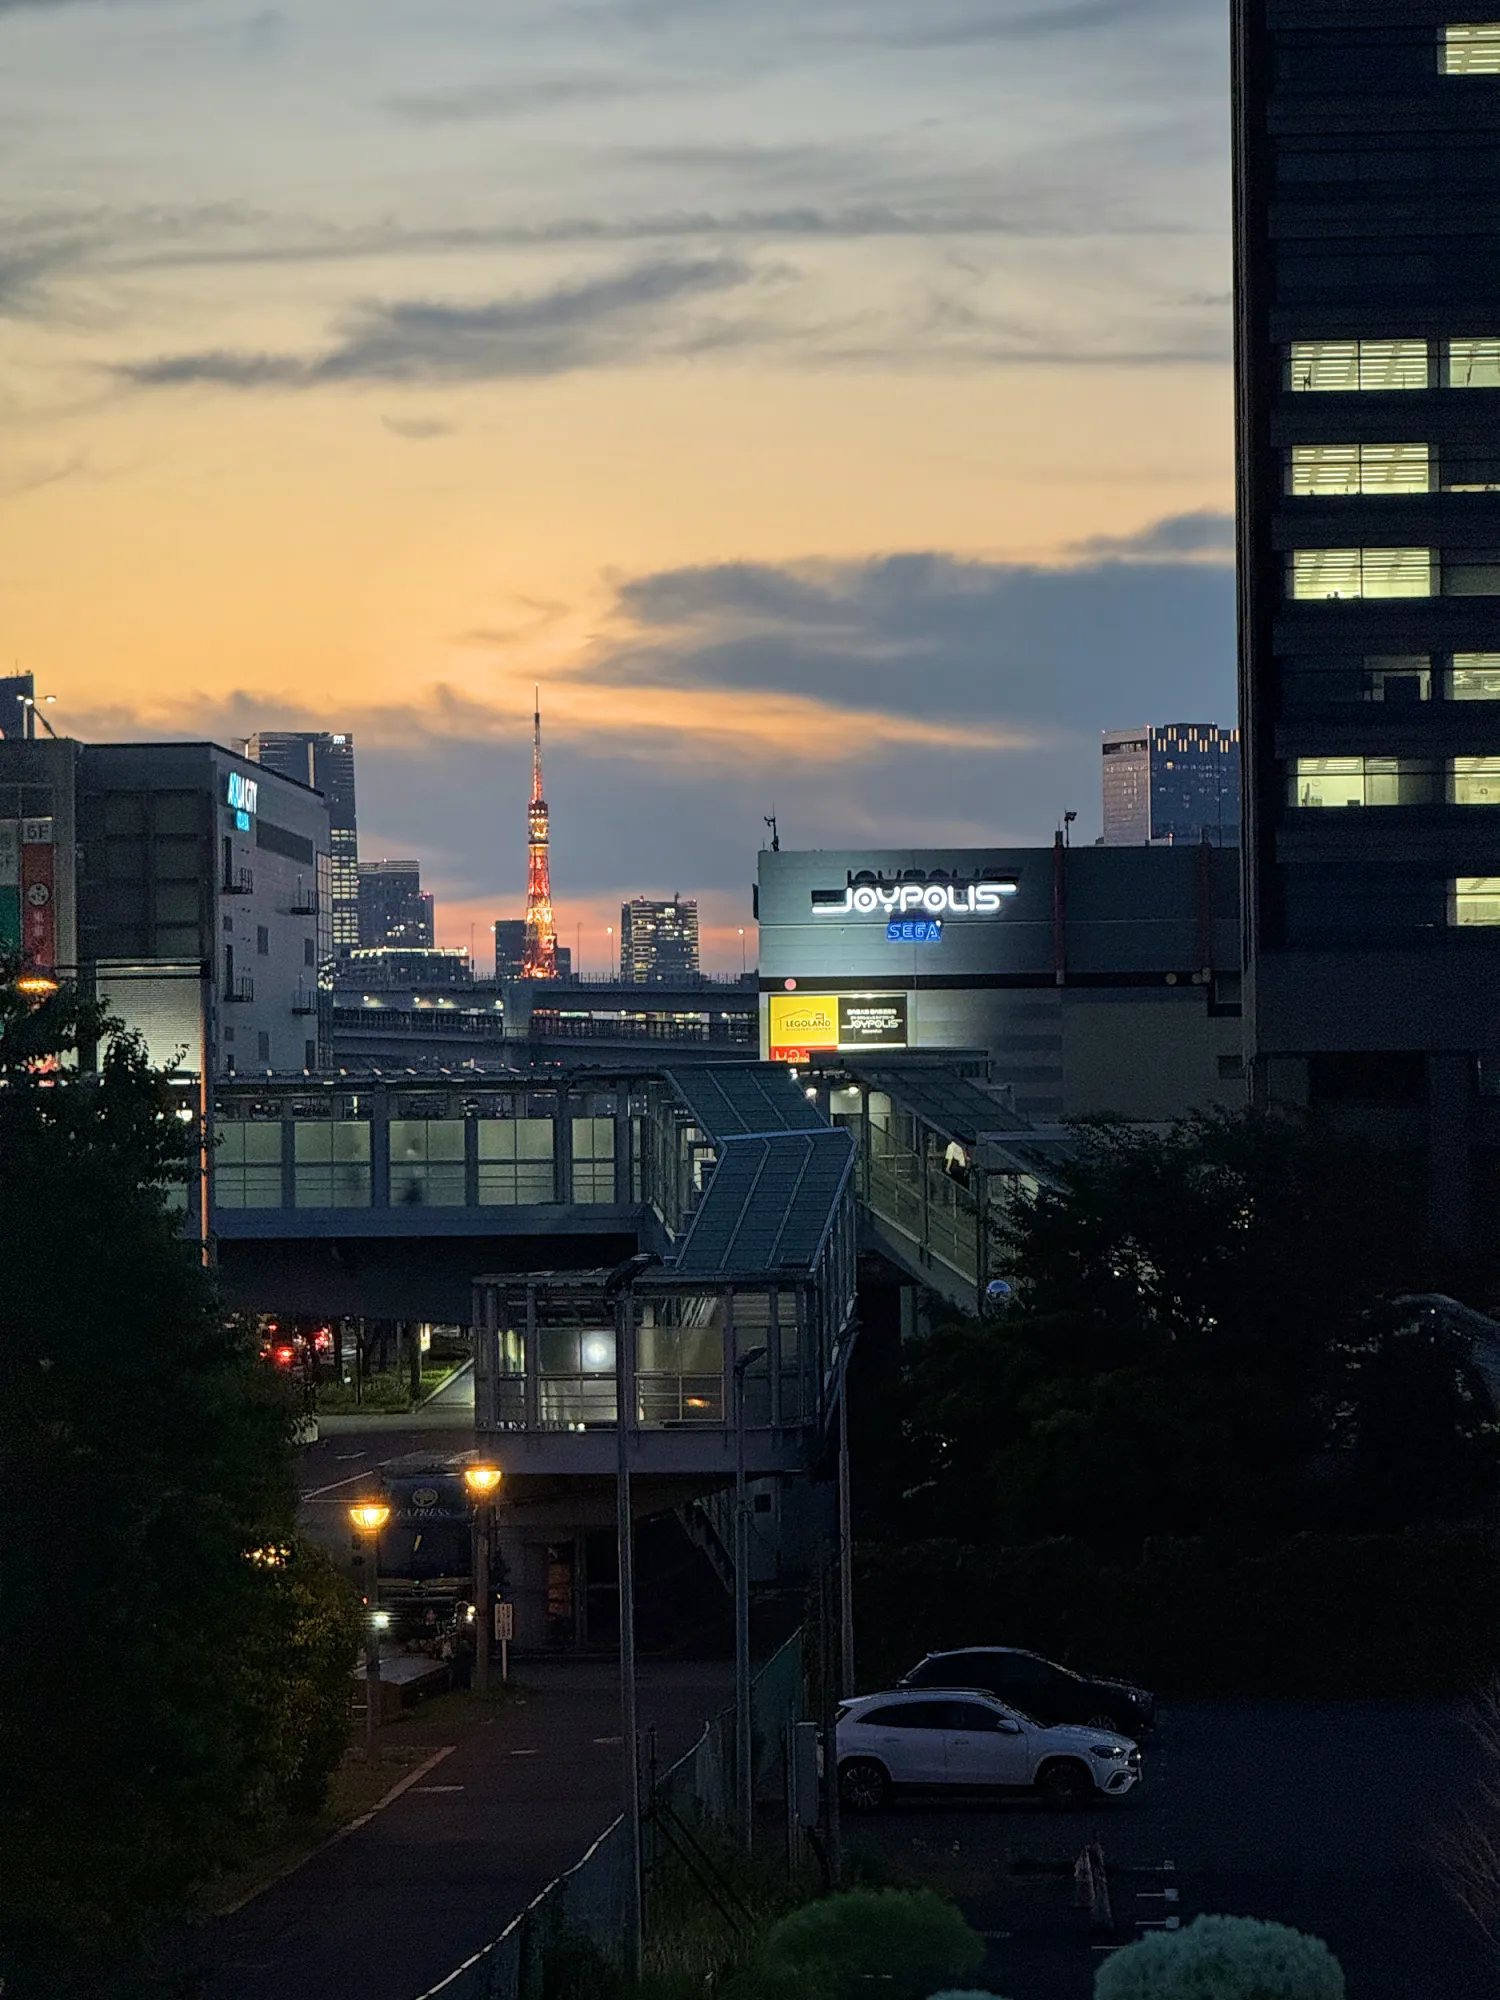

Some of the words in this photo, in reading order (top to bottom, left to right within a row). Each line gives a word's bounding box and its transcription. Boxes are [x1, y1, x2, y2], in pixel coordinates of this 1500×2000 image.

[27, 825, 49, 839] 5F
[812, 884, 1017, 912] JOYPOLIS
[888, 921, 941, 940] SEGA
[841, 1019, 903, 1028] JOYPOLIS
